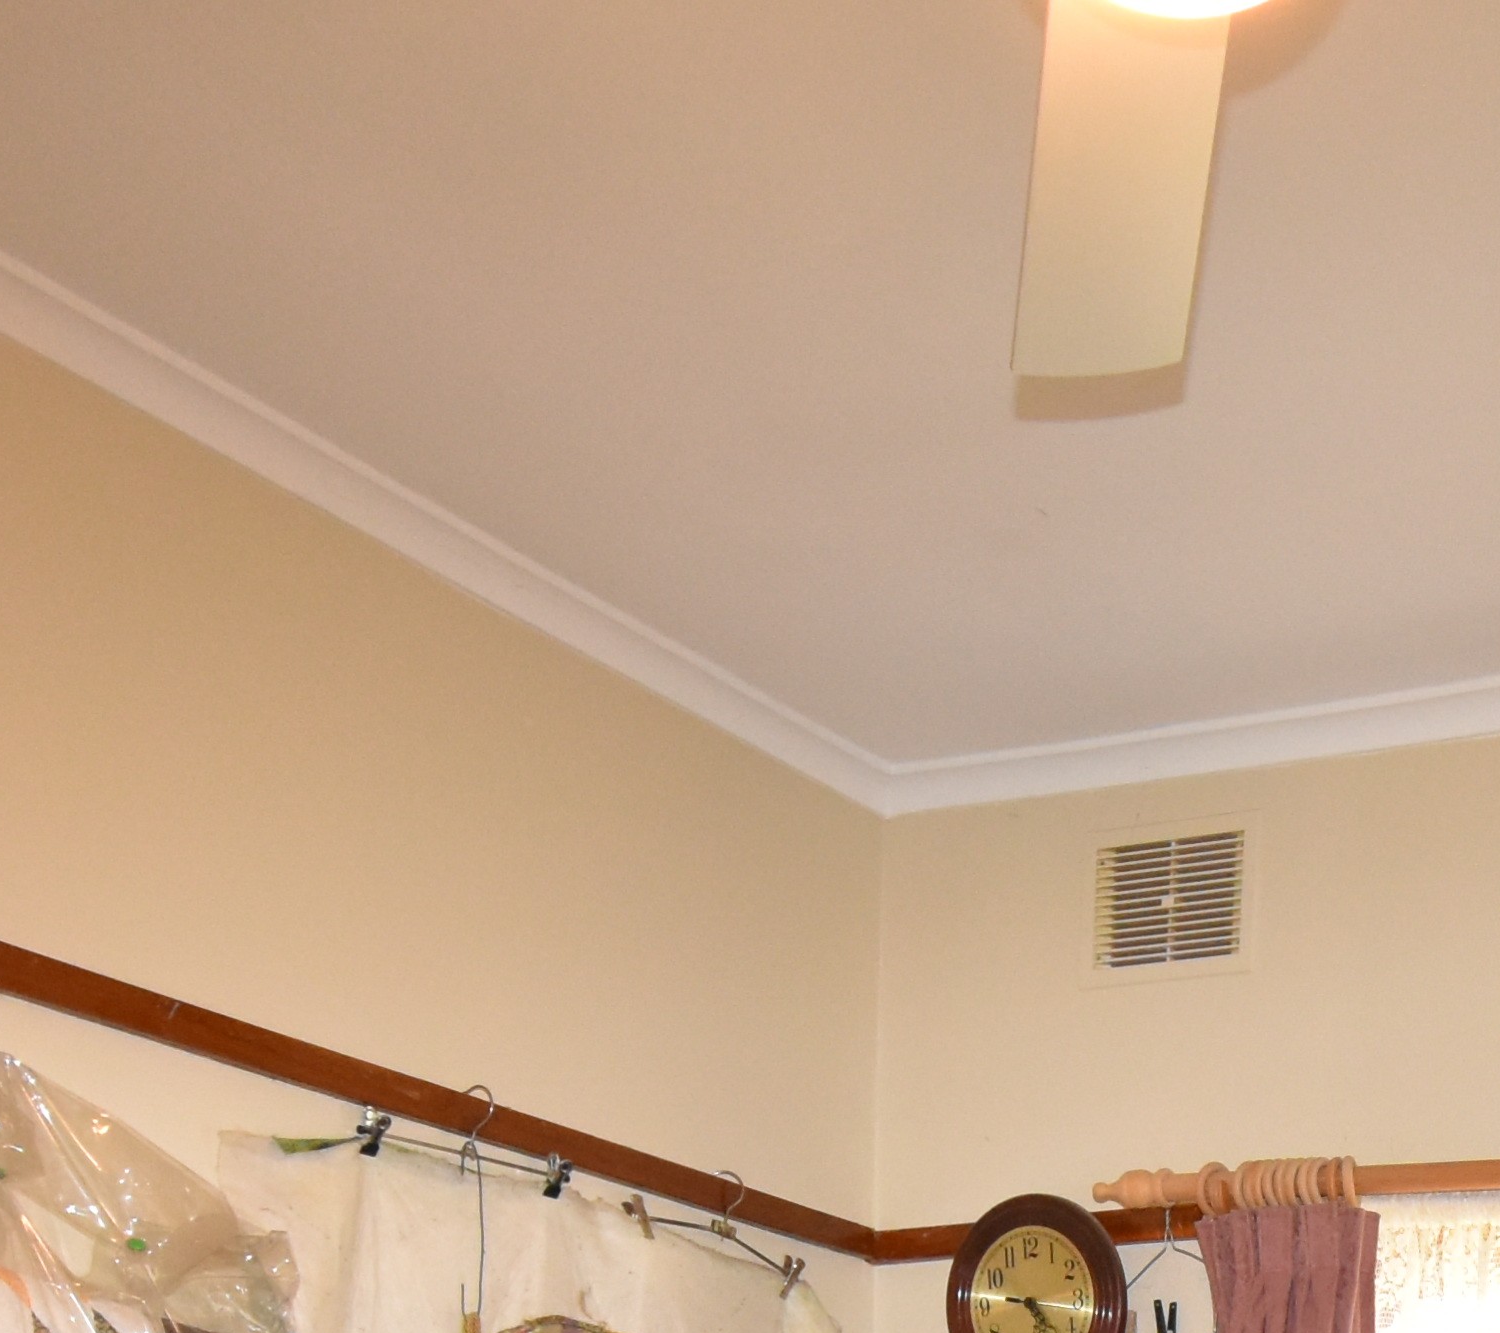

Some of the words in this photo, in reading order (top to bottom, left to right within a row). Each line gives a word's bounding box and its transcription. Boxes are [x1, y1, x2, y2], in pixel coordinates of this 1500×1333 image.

[1004, 1246, 1015, 1269] 11
[1022, 1236, 1039, 1260] 12
[987, 1268, 1004, 1290] 10
[1064, 1259, 1075, 1281] 2
[979, 1296, 990, 1317] 9
[1072, 1288, 1084, 1311] 3
